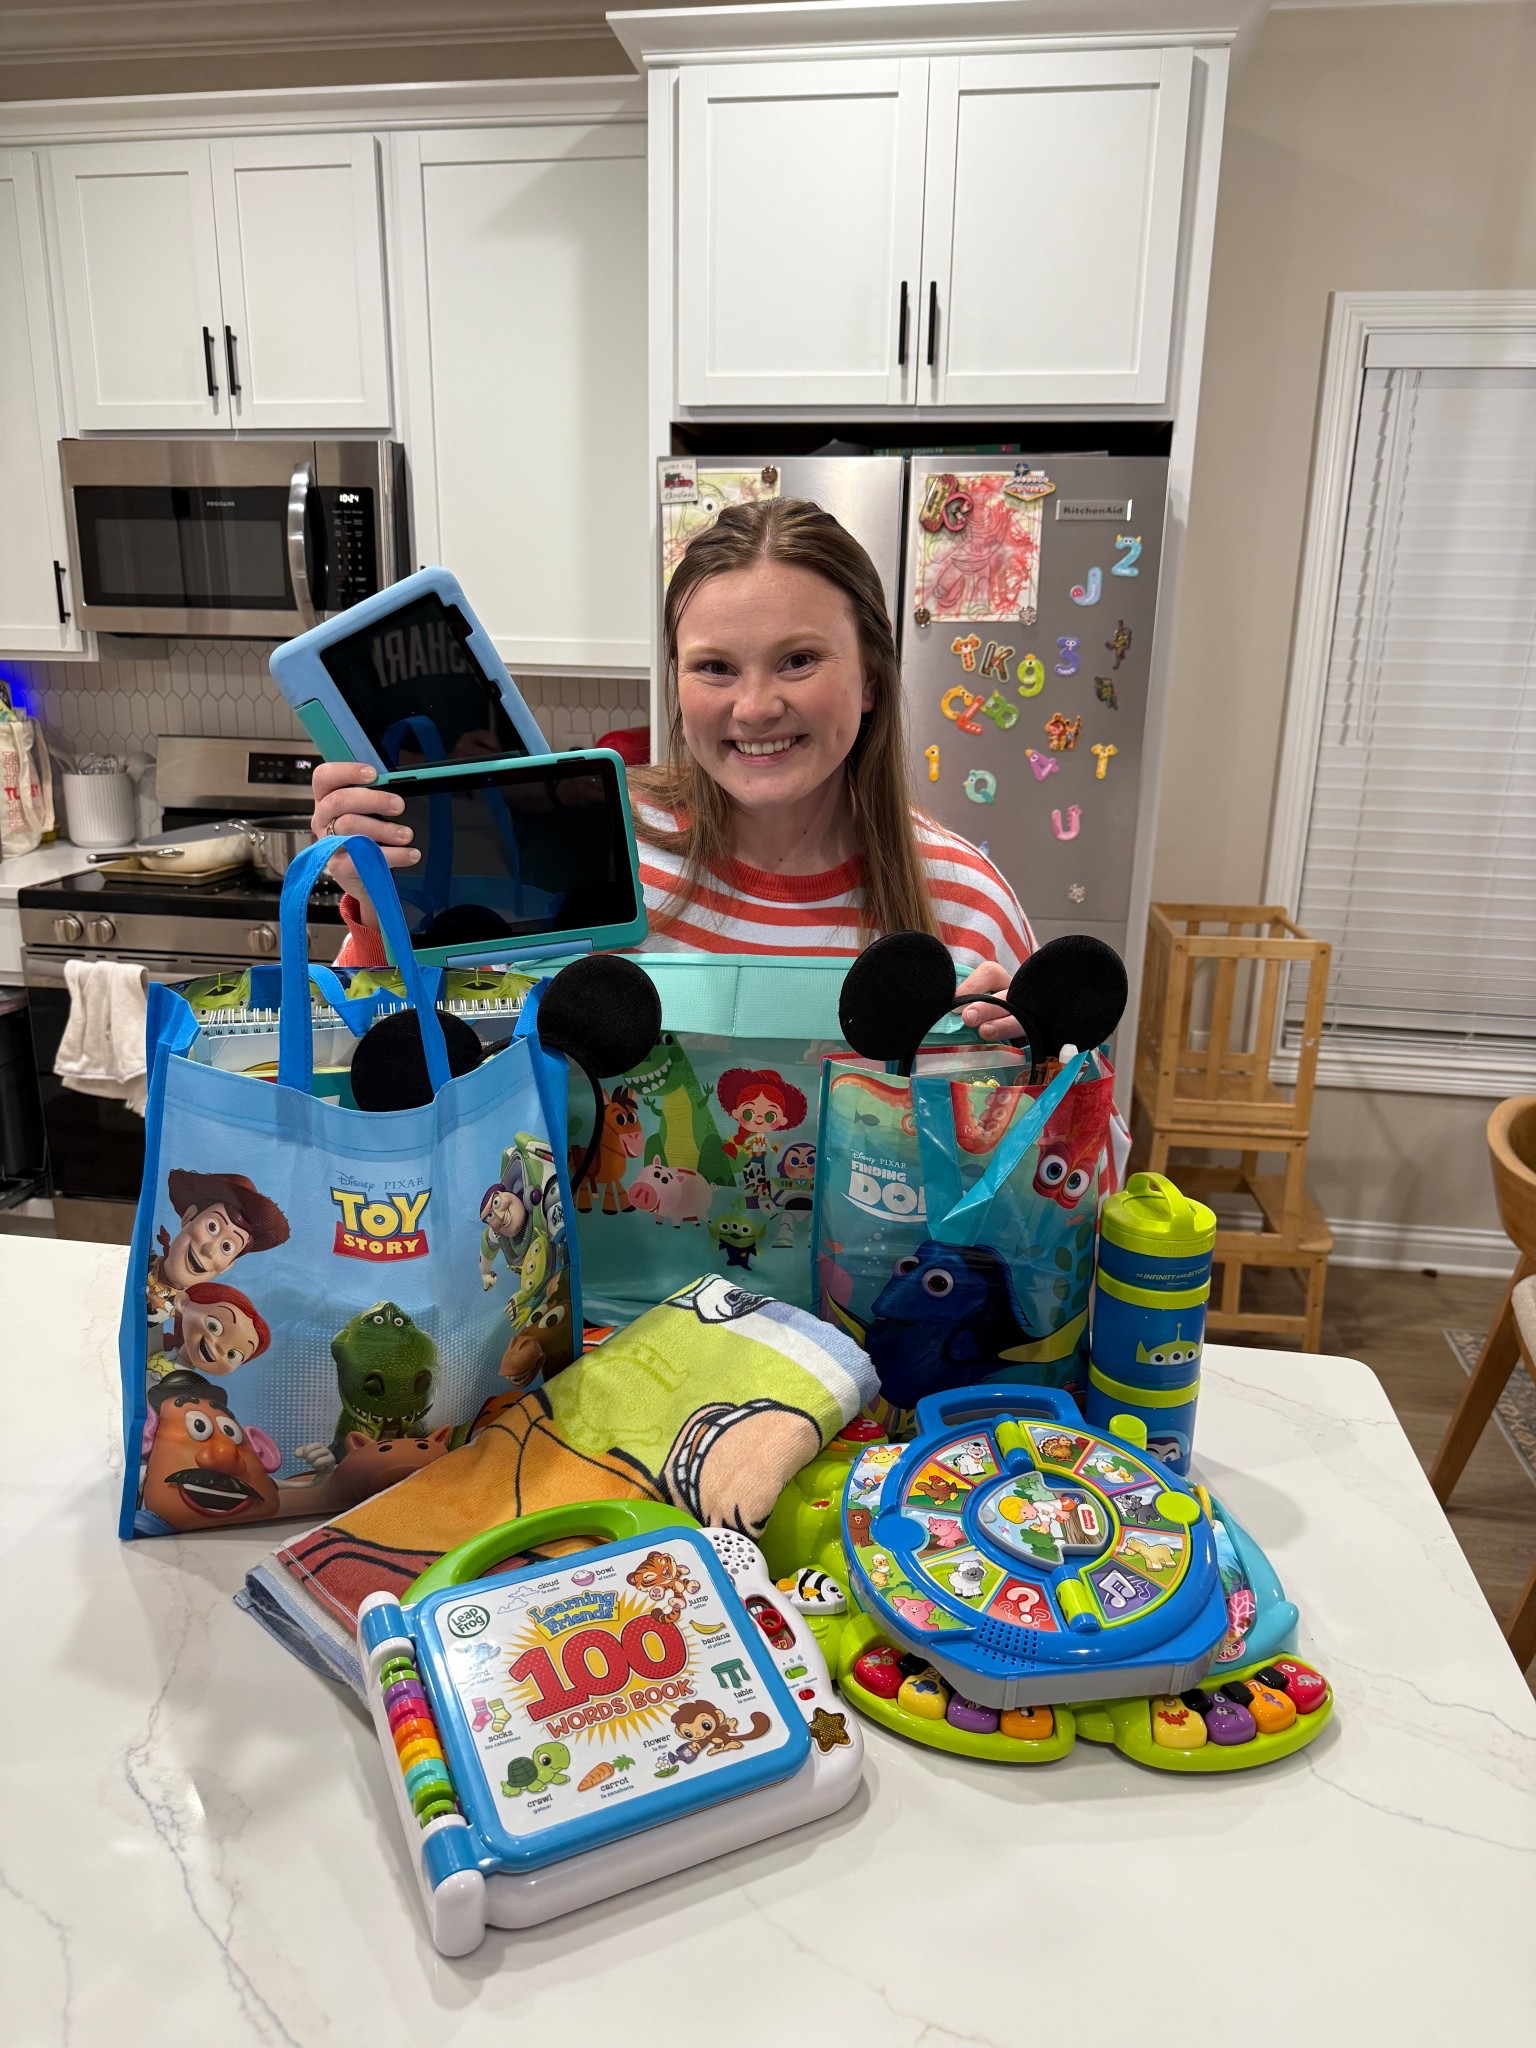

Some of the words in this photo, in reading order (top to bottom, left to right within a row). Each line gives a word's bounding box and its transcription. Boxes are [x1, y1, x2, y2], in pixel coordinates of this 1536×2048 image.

[1063, 506, 1123, 515] KitchenAid
[979, 641, 1016, 683] K
[1054, 636, 1081, 676] 3
[1016, 653, 1045, 698] 9
[1051, 804, 1082, 841] U
[879, 1157, 907, 1170] PIXAR
[851, 1160, 907, 1183] FINDING
[335, 1170, 376, 1193] Disney
[384, 1177, 425, 1190] PIXAR
[330, 1186, 432, 1240] TOY
[343, 1233, 420, 1255] STORY
[1143, 1273, 1177, 1281] INFINITY
[595, 1565, 615, 1576] bowl
[537, 1579, 560, 1590] cloud
[529, 1591, 616, 1624] Learning
[688, 1595, 709, 1607] jump
[451, 1606, 479, 1627] Leap
[457, 1614, 486, 1634] Frog
[544, 1603, 614, 1636] Friends
[701, 1631, 731, 1645] banana
[508, 1614, 687, 1722] 100
[923, 1668, 939, 1680] 2
[1281, 1663, 1297, 1673] 8
[733, 1687, 754, 1699] table
[1247, 1681, 1262, 1692] 7
[1213, 1693, 1226, 1703] 6
[545, 1697, 628, 1739] WORDS
[628, 1678, 696, 1710] BOOK
[488, 1729, 514, 1743] socks
[643, 1734, 671, 1748] flower
[600, 1776, 630, 1792] carrot
[527, 1793, 553, 1808] crawl
